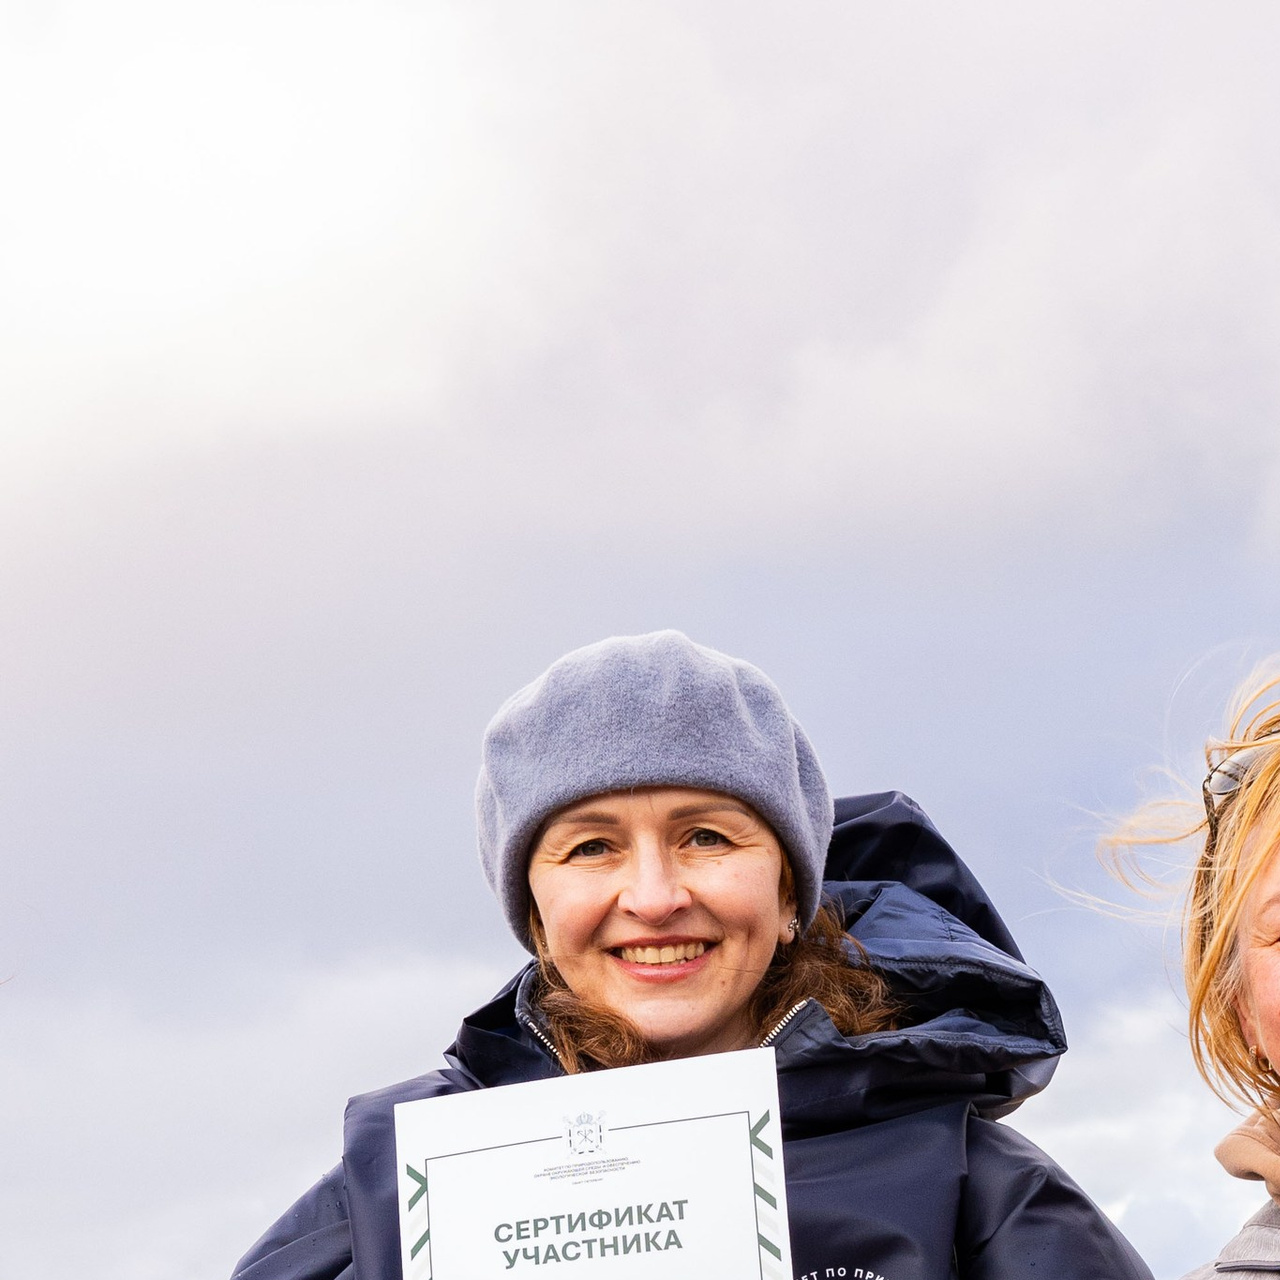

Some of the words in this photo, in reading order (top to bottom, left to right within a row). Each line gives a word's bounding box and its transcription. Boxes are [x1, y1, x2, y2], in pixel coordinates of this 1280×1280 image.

[494, 1199, 689, 1243] СЕРТИФИКАТ
[502, 1229, 683, 1269] УЧАСТНИКА
[825, 1267, 847, 1278] ПО
